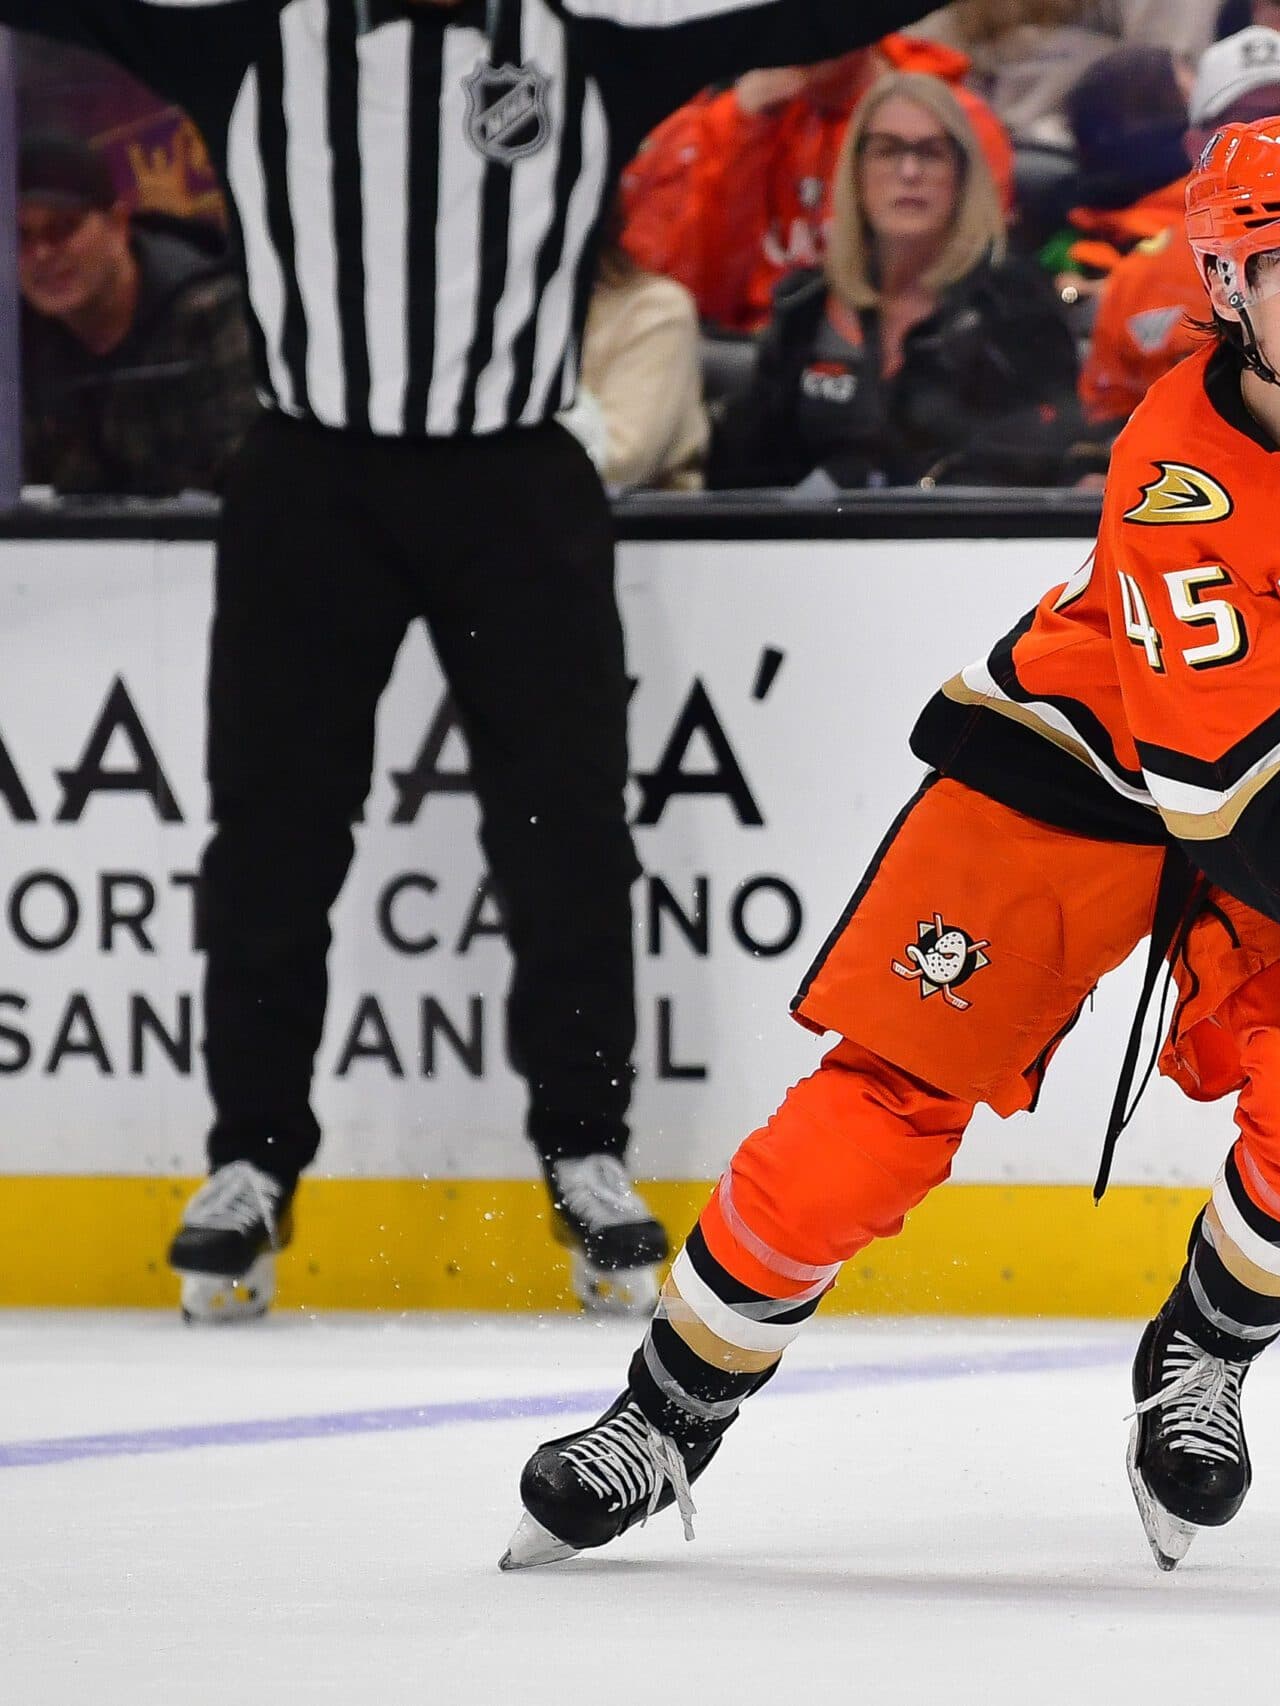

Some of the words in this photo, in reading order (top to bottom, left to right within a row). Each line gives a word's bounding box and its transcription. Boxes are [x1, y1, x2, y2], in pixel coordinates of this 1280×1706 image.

[1116, 565, 1250, 676] 45
[376, 871, 804, 958] CANO
[0, 992, 192, 1075] SAN
